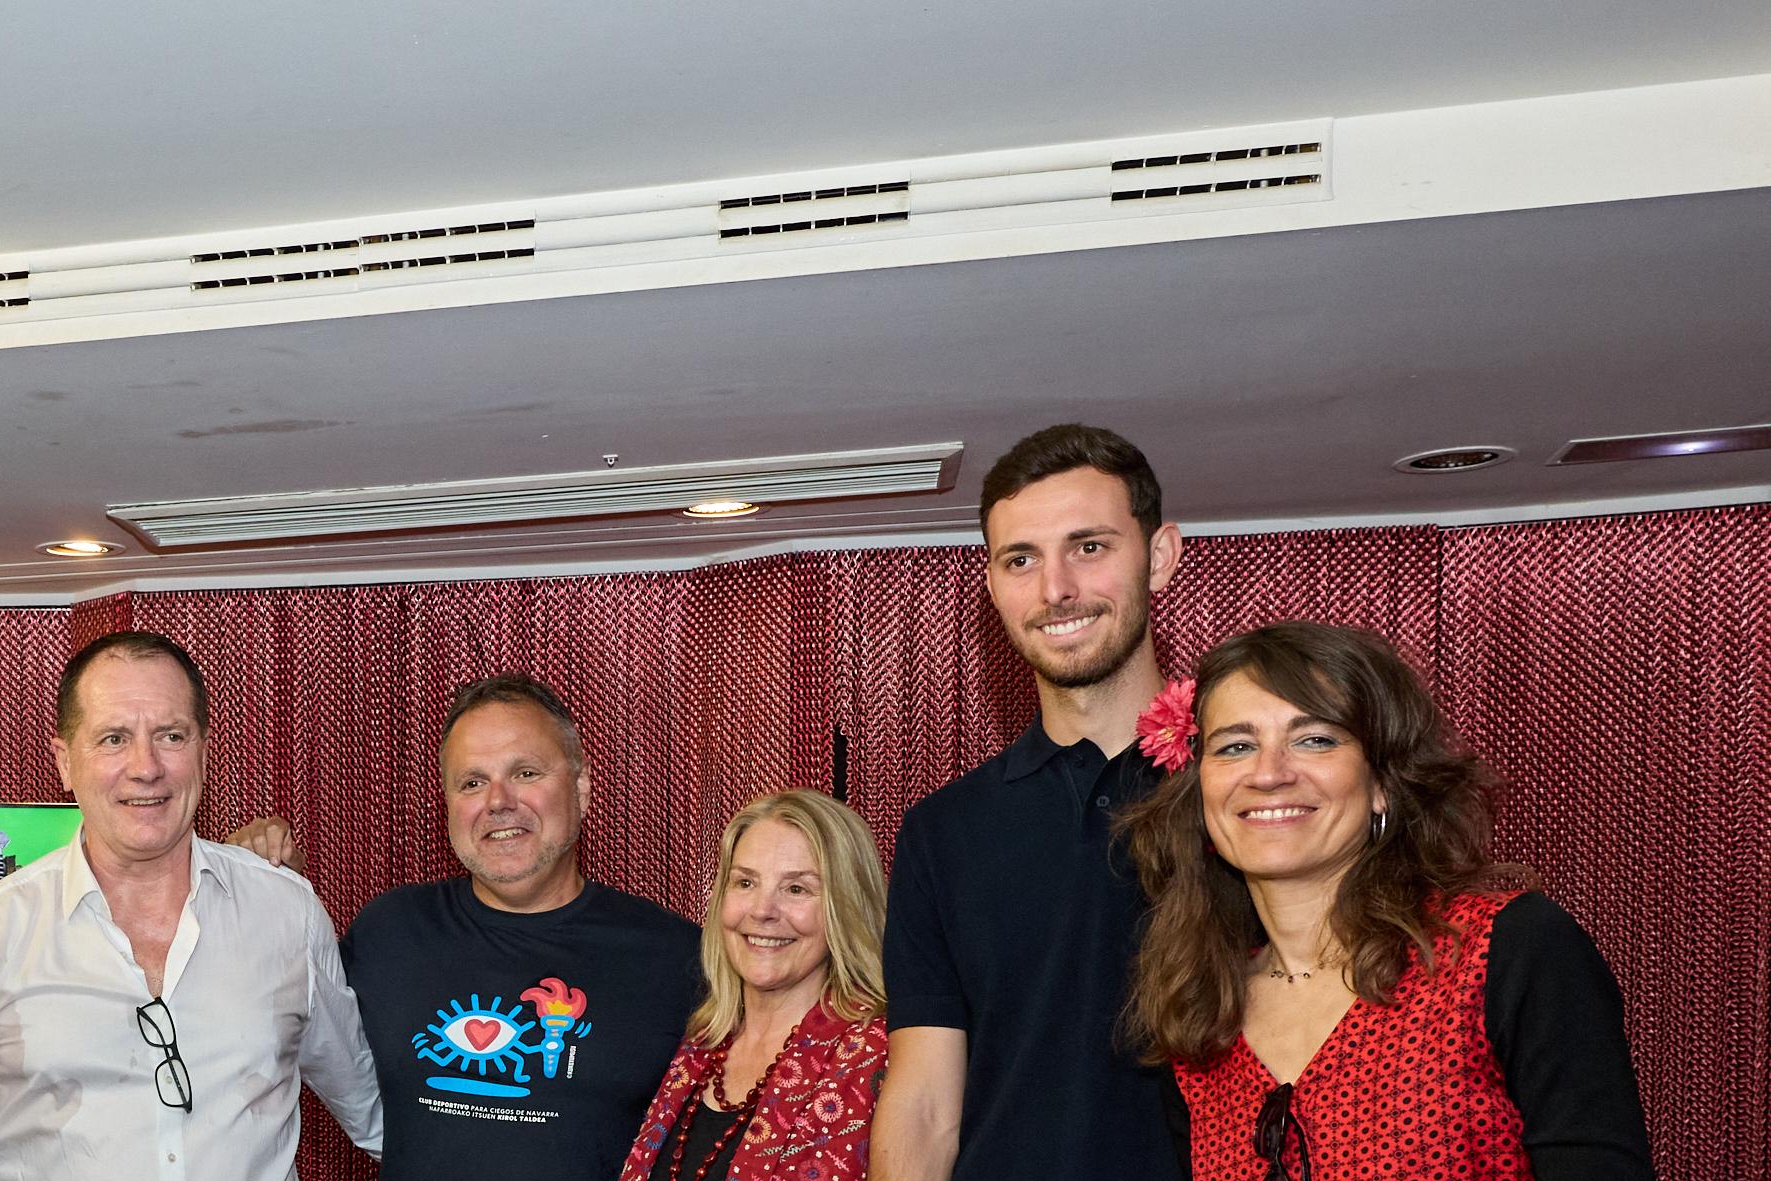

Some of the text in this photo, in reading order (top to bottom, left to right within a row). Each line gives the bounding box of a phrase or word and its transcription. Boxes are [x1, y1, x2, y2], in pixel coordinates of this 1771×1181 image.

[418, 1097, 432, 1105] CLUB
[433, 1100, 469, 1111] DEPORTIVO
[470, 1105, 488, 1113] PARA
[490, 1107, 514, 1115] CIEGOS
[527, 1110, 560, 1118] NAVARRA
